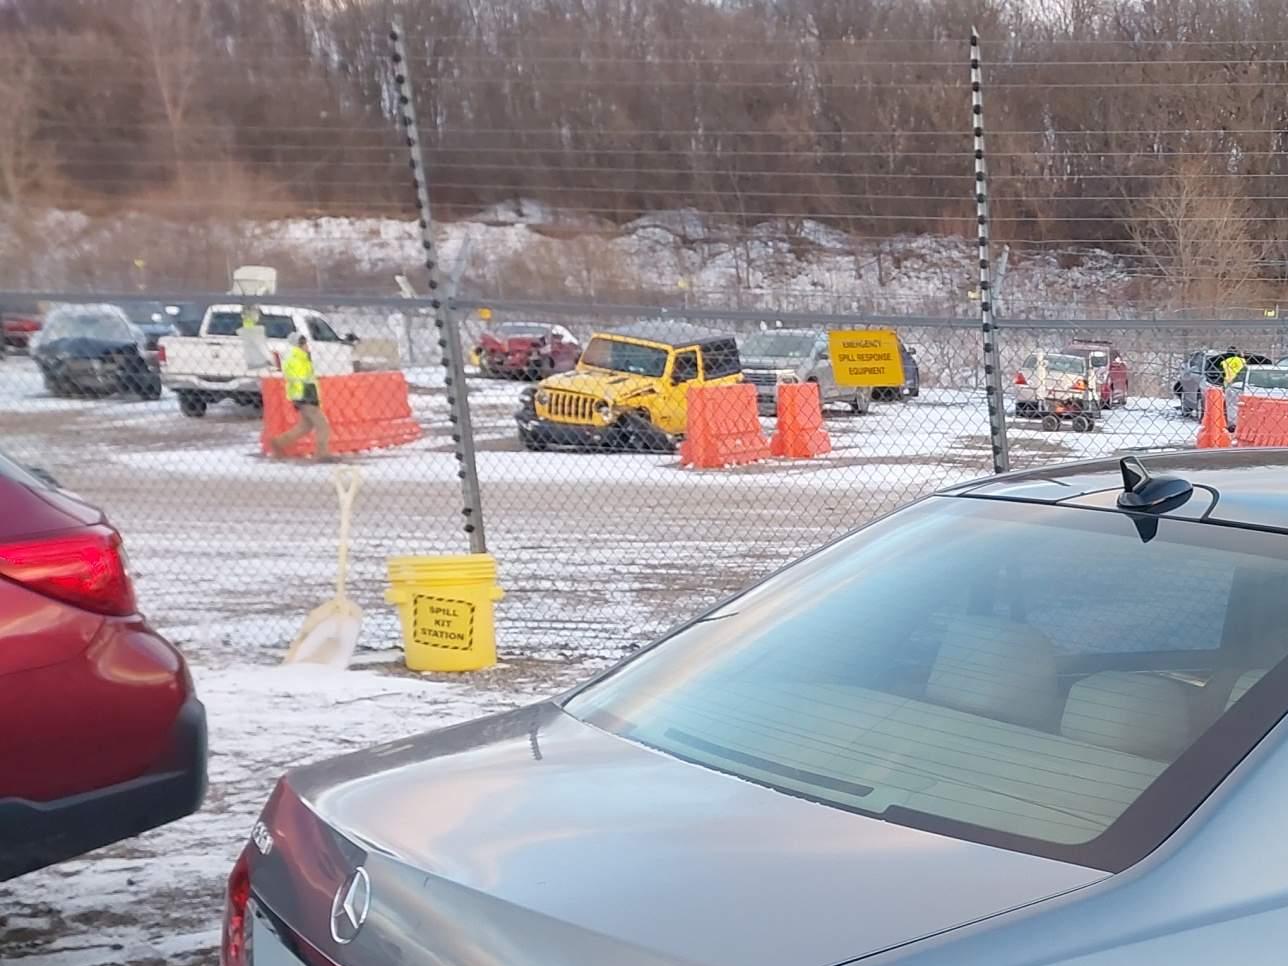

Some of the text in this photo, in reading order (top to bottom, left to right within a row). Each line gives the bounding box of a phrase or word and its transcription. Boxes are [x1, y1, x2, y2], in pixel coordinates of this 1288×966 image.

[842, 340, 881, 349] EMERGENCY
[838, 353, 892, 362] SPILL RESPONSE
[848, 367, 885, 375] EQUIPMENT
[429, 606, 458, 616] SPILL
[434, 619, 452, 627] KIT
[421, 627, 464, 640] STATION
